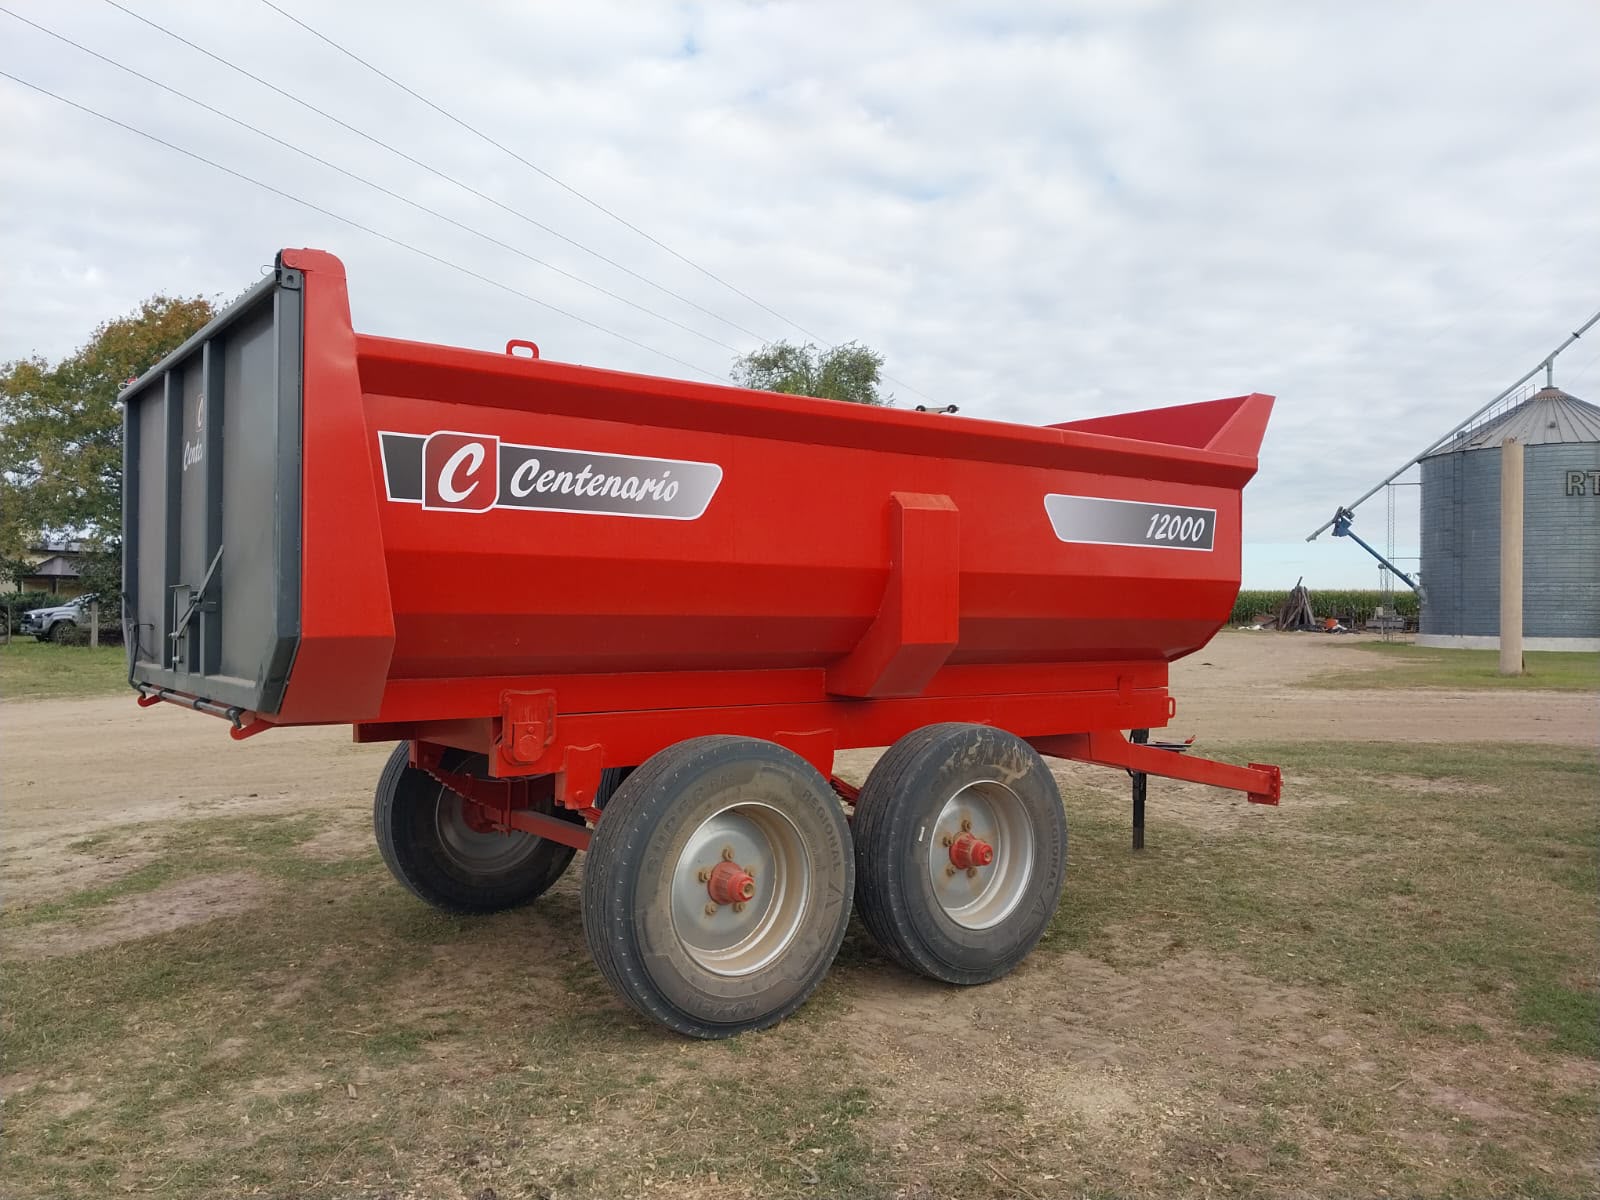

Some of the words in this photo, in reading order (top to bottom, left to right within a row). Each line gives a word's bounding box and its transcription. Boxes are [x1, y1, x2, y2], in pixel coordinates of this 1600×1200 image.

[438, 443, 485, 503] C
[510, 458, 680, 502] Centenario
[1146, 513, 1206, 542] 12000
